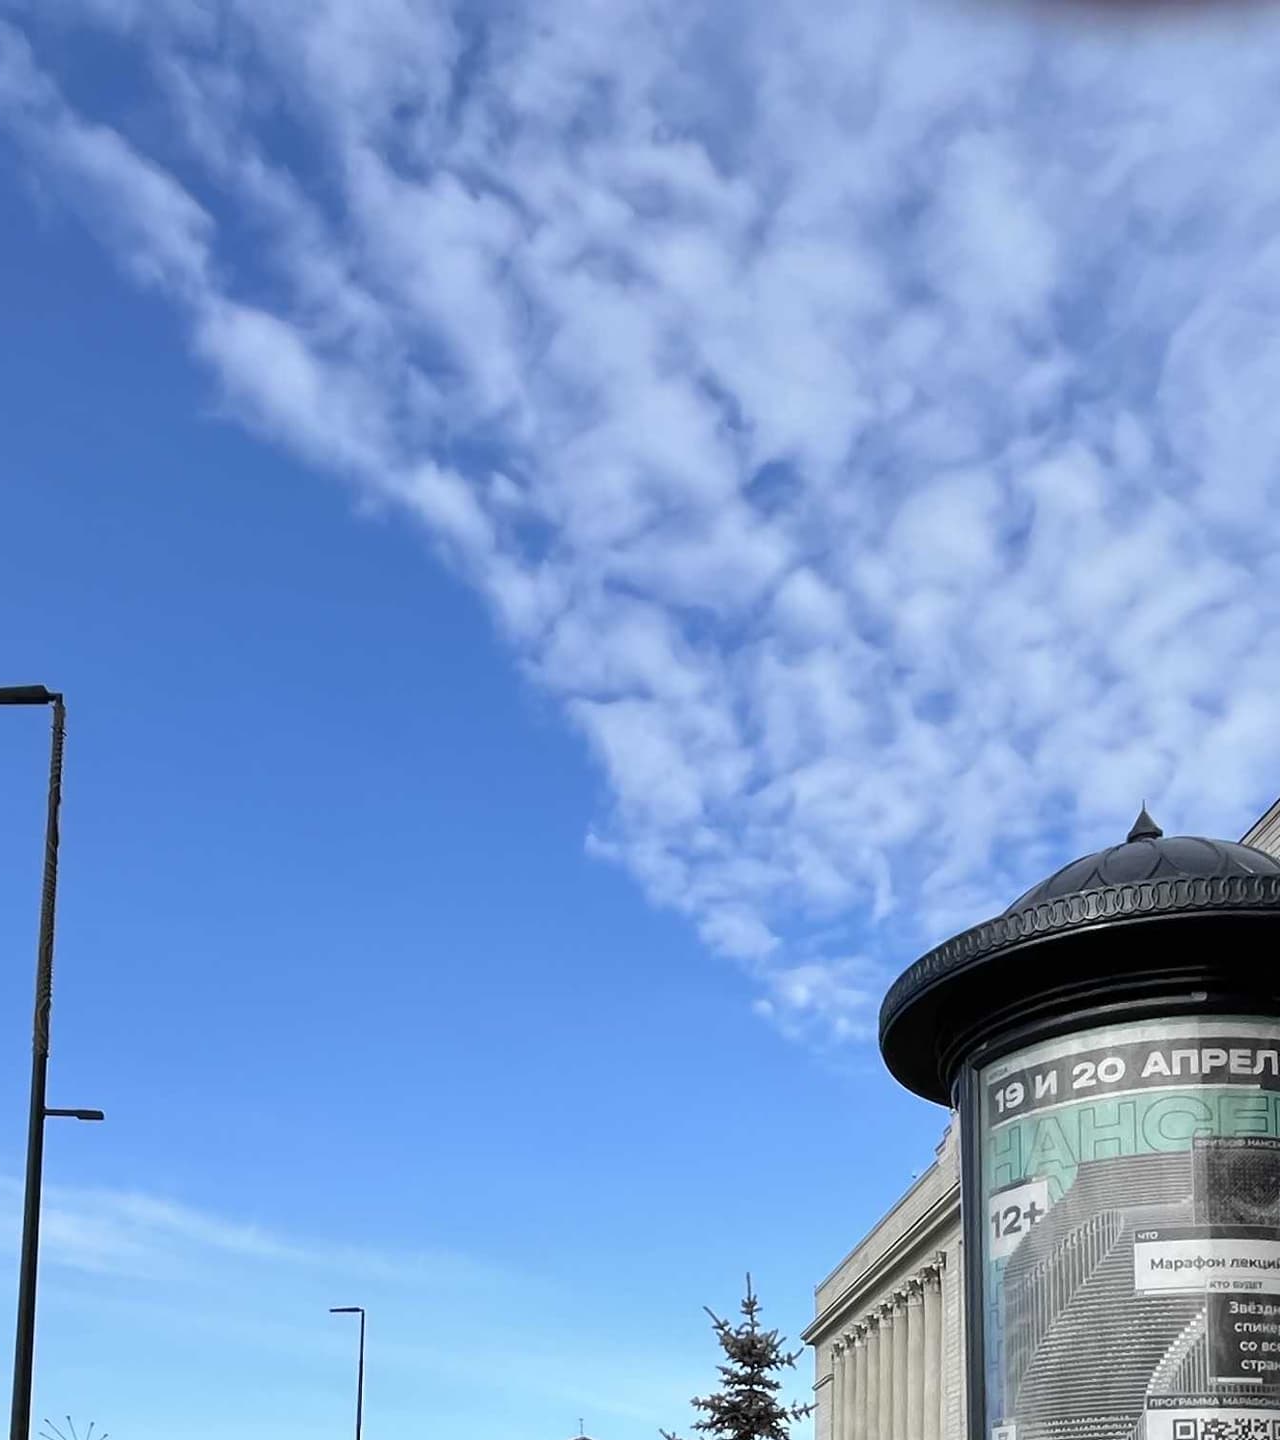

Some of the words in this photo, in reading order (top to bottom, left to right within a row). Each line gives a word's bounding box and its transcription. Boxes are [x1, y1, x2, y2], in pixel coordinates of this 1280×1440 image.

[995, 1082, 1024, 1112] 19
[1034, 1070, 1057, 1099] И
[1072, 1057, 1125, 1089] 20
[991, 1201, 1044, 1238] 12+
[1138, 1231, 1158, 1240] ЧТО
[1150, 1256, 1226, 1272] Марафон
[1209, 1281, 1230, 1289] КТО
[1240, 1341, 1258, 1351] со
[1148, 1397, 1220, 1407] ПРОГРАММА
